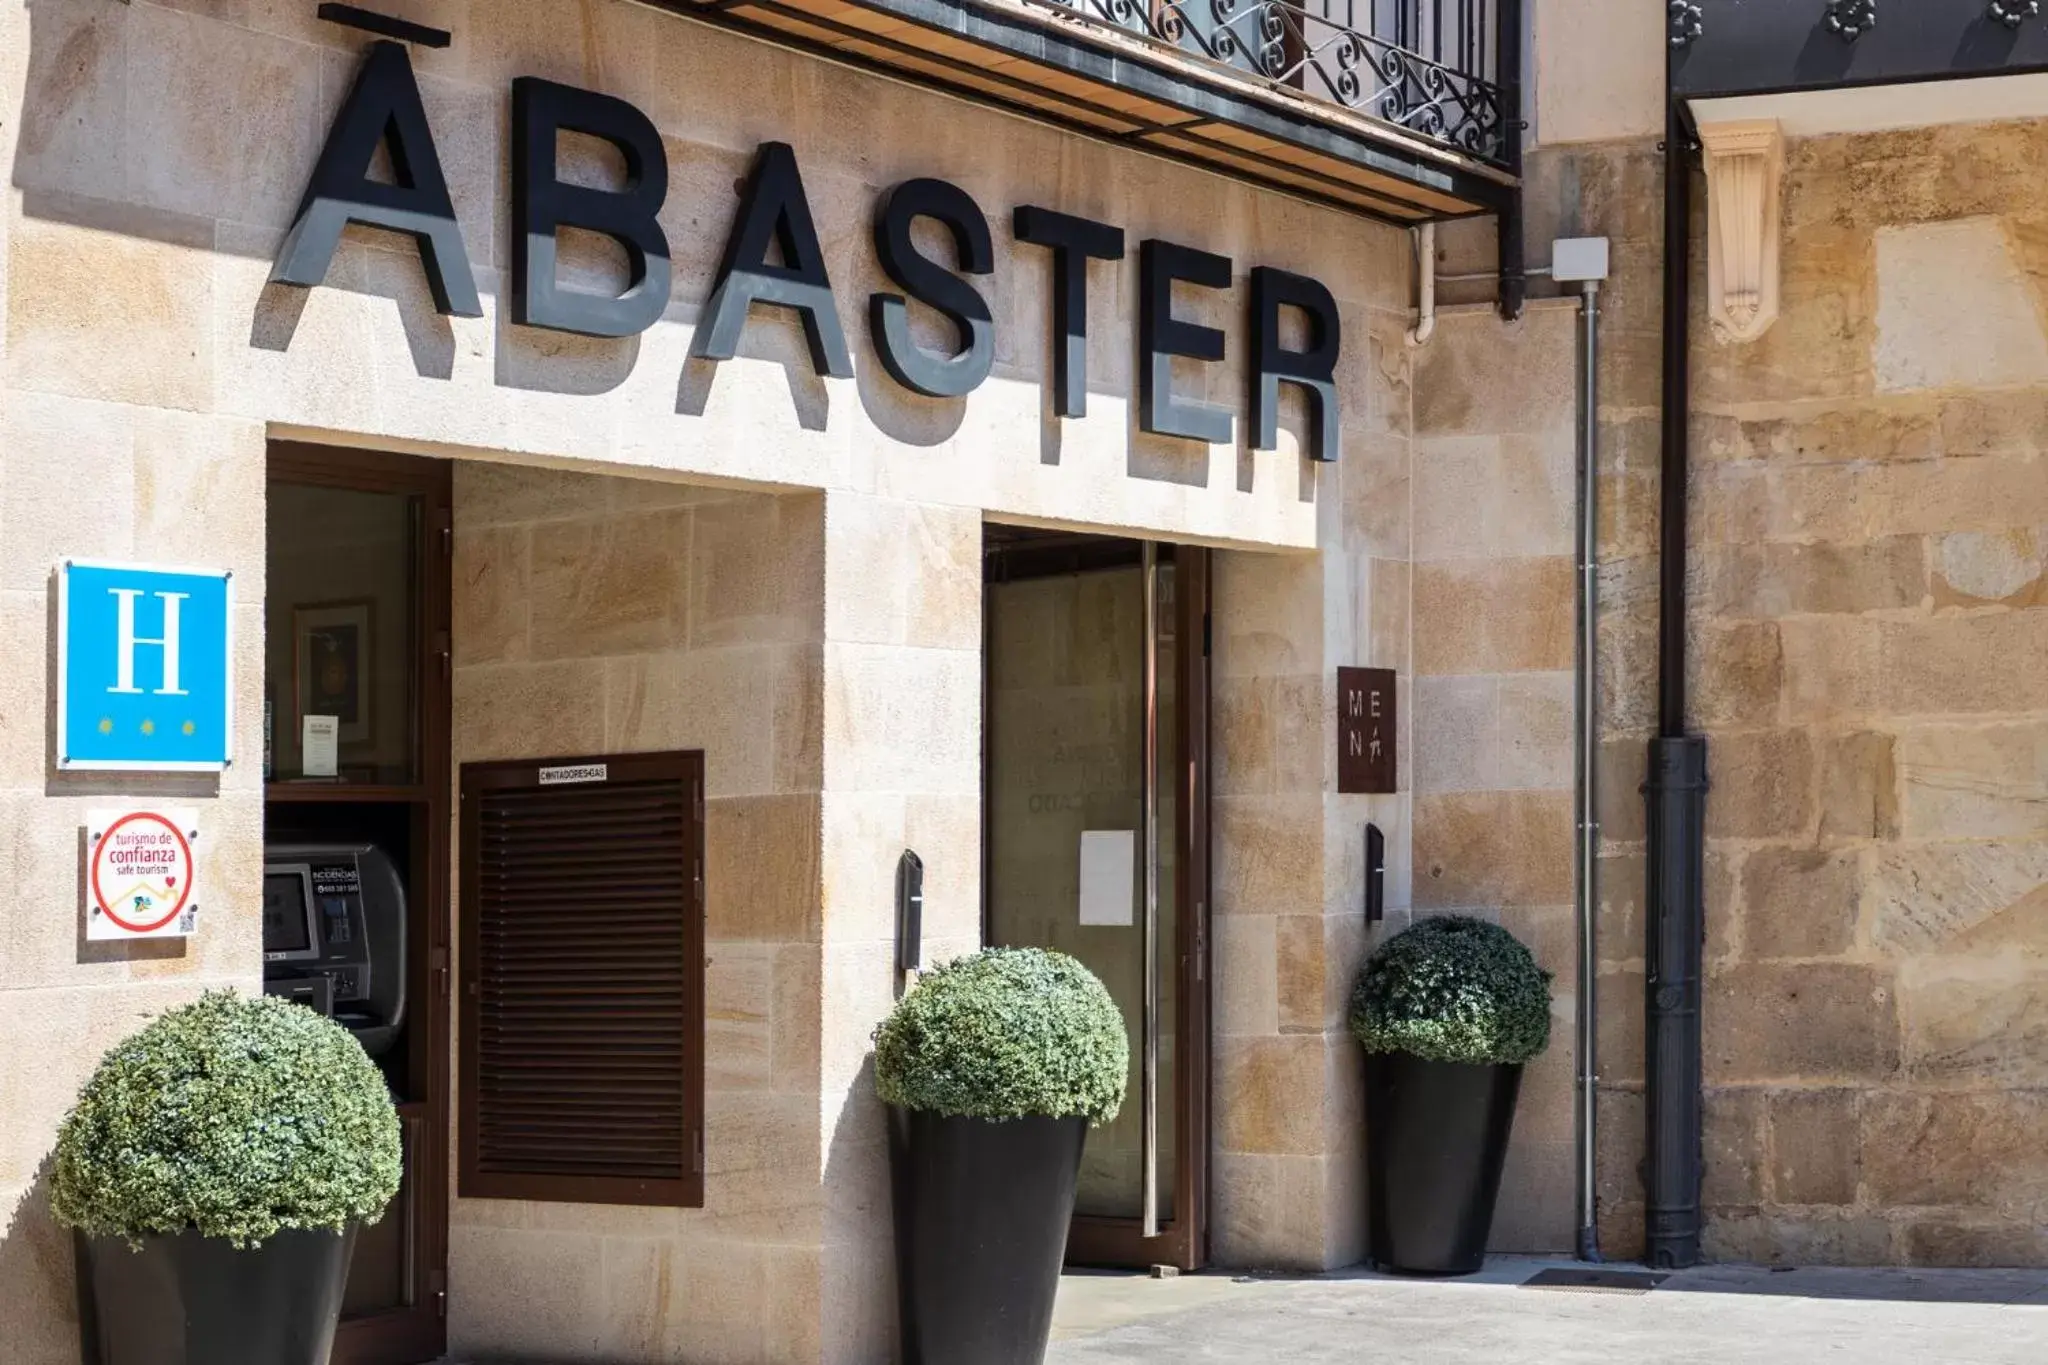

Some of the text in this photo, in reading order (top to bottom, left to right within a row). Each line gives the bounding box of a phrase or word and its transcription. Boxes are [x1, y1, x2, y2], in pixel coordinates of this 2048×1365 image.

[106, 587, 191, 696] H
[115, 831, 172, 845] turismo de
[109, 846, 176, 863] confianza
[116, 863, 169, 876] safe tourism
